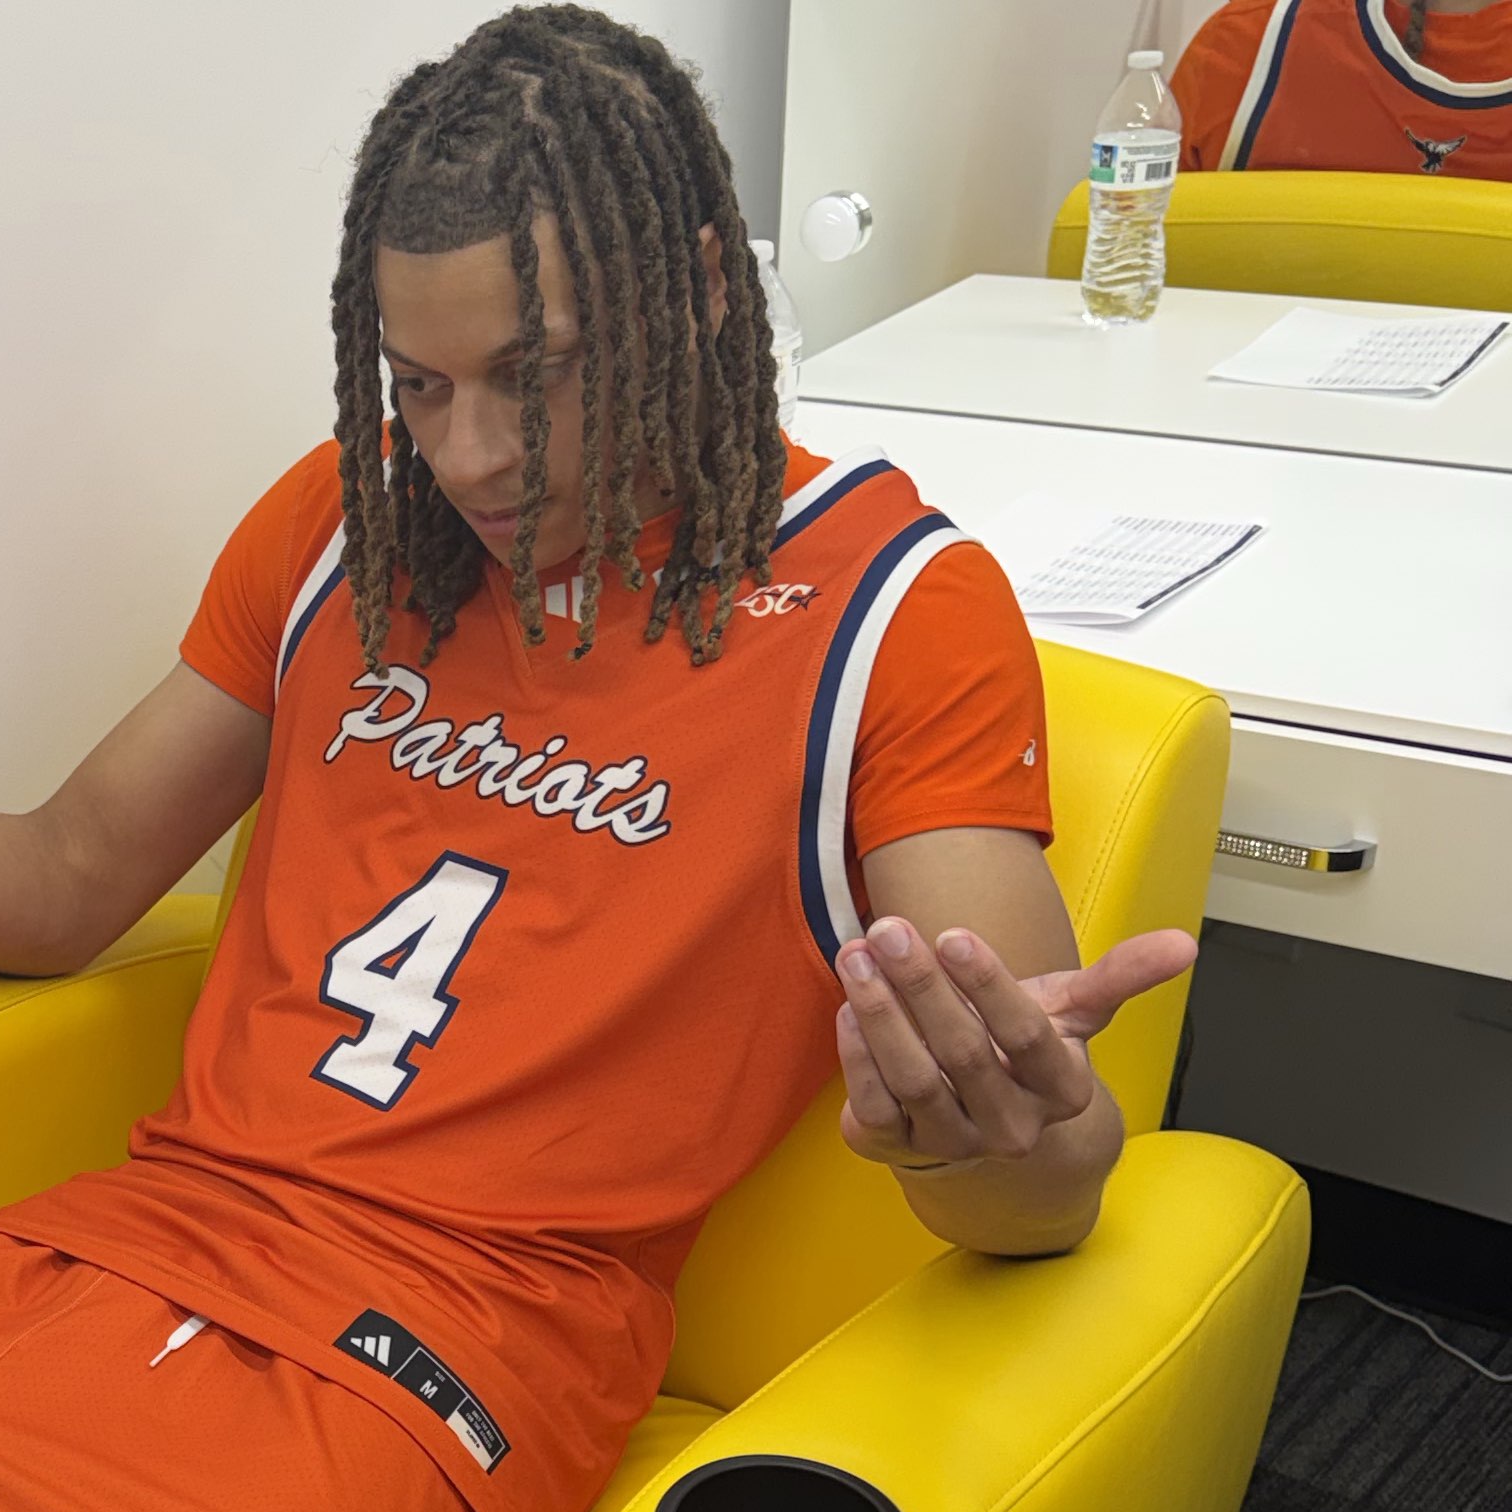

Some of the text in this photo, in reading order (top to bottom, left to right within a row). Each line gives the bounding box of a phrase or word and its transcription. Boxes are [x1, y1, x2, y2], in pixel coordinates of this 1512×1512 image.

[324, 664, 671, 846] Patriots
[309, 850, 509, 1111] 4
[419, 1379, 438, 1400] M
